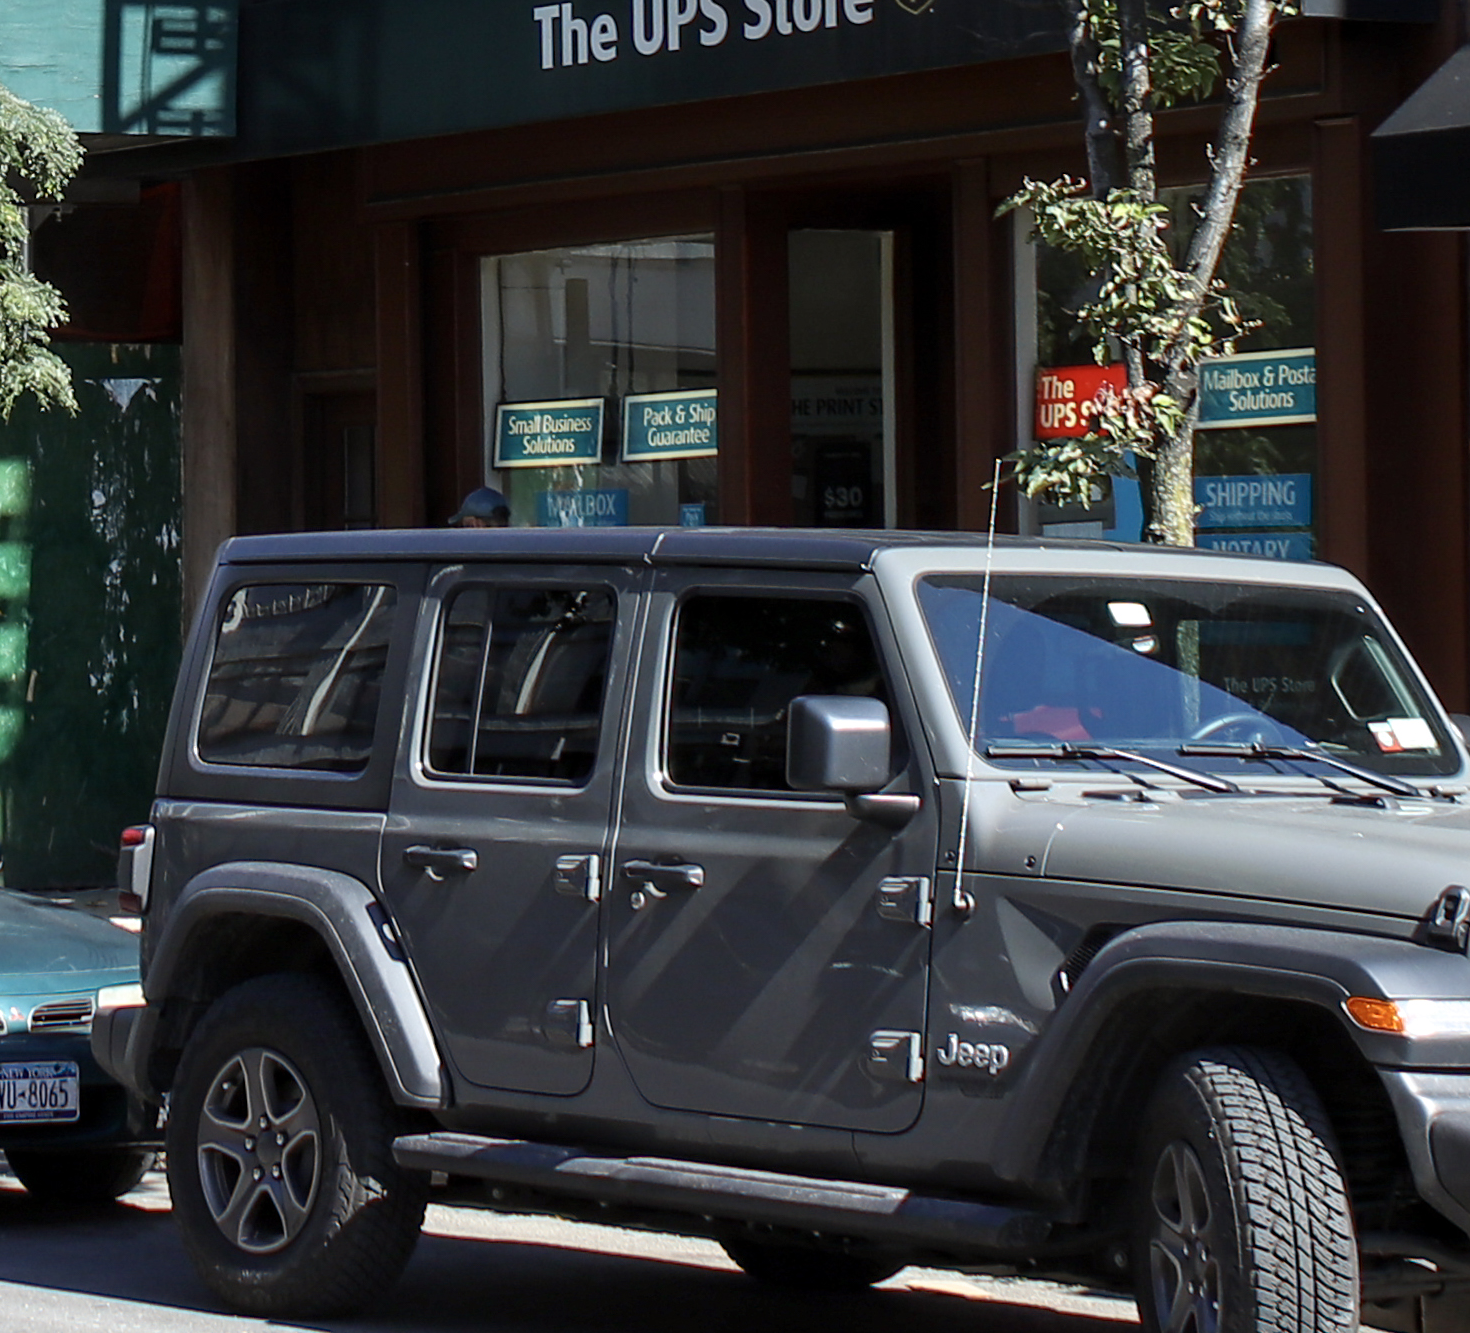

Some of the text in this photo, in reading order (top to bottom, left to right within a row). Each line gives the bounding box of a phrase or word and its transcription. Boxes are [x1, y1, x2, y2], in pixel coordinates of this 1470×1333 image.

[533, 1, 618, 69] The
[1041, 375, 1075, 400] The
[1203, 368, 1261, 392] Mailbox
[1262, 365, 1276, 387] &
[816, 398, 864, 416] PRINT
[1228, 389, 1295, 412] Solutions
[508, 413, 592, 436] Small Business
[643, 402, 716, 427] Pack & Ship
[1040, 402, 1076, 428] UPS
[522, 435, 576, 455] Solutions
[648, 428, 710, 448] Guarantee
[823, 486, 864, 508] $30
[1206, 480, 1296, 508] SHIPPING
[1223, 676, 1248, 694] The
[1251, 676, 1277, 693] UPS
[936, 1032, 1010, 1075] Jeep
